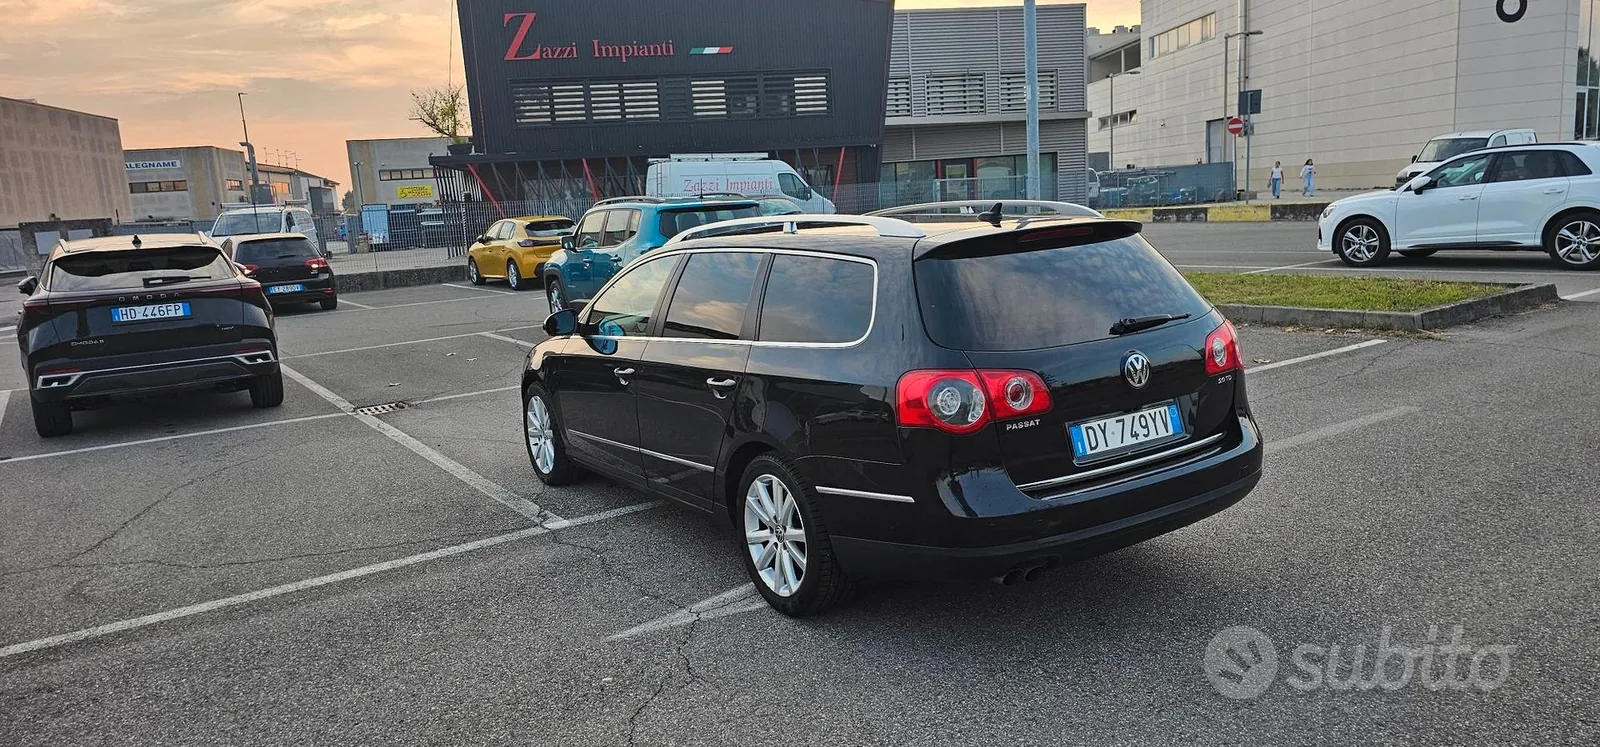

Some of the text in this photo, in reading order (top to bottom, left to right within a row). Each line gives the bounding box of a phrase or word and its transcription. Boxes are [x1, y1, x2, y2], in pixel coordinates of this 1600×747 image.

[503, 12, 674, 62] Zazzi Impianti
[683, 177, 773, 192] Zazzi Impianti
[120, 304, 181, 321] HD 446FP
[1006, 418, 1041, 431] PASSAT
[1085, 422, 1109, 451] DY
[1115, 408, 1170, 444] 749YV
